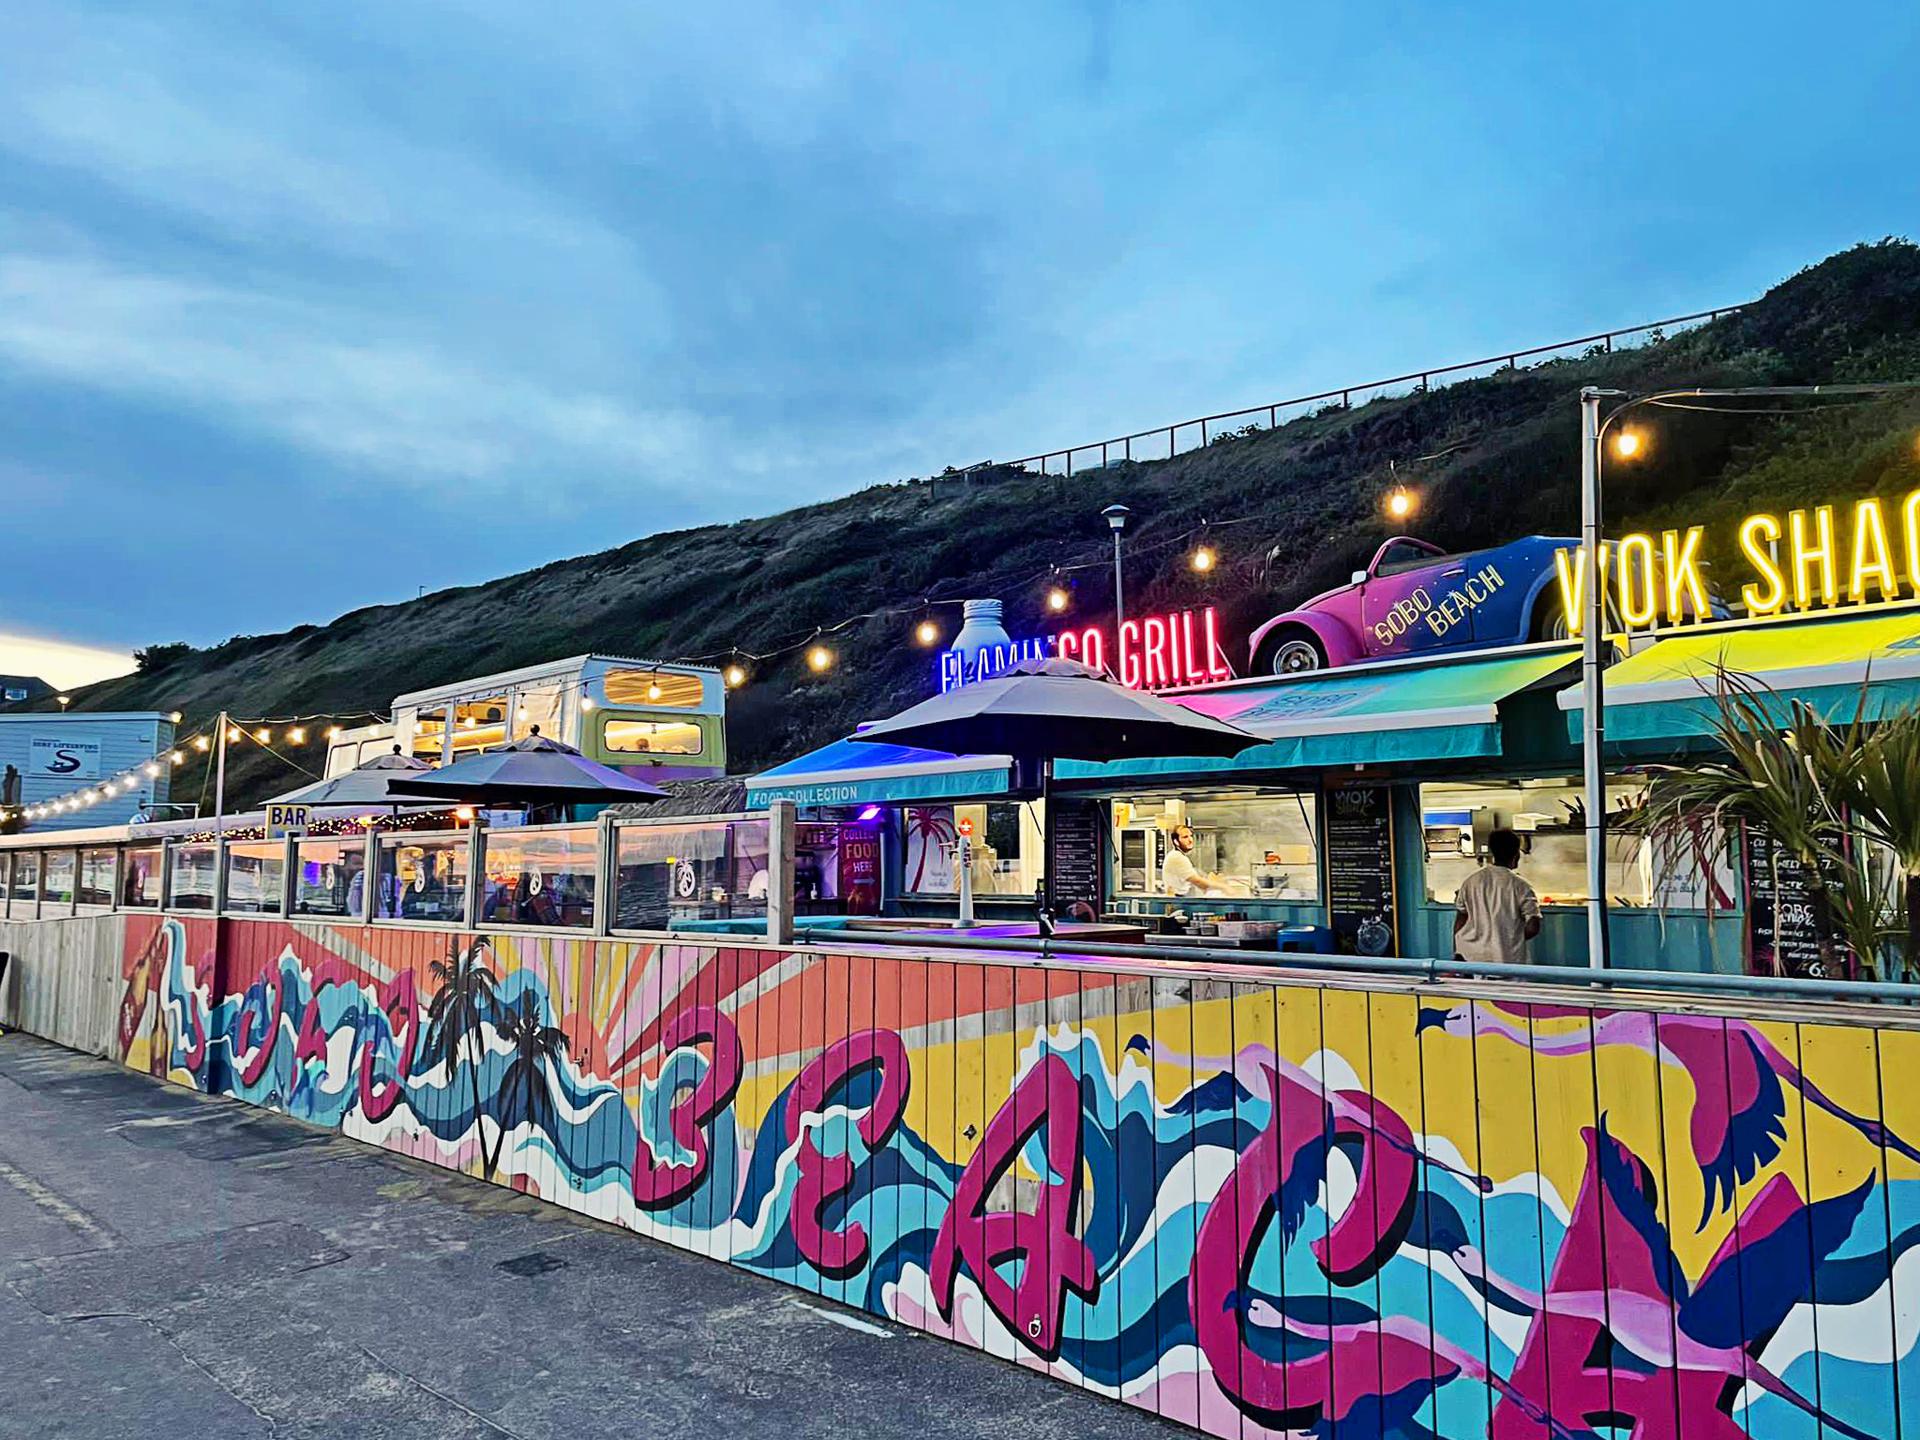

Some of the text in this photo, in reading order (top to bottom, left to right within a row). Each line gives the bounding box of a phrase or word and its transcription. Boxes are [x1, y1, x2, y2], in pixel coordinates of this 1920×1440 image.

[1555, 525, 1713, 635] WOK
[1425, 564, 1505, 637] BEACH
[1374, 588, 1433, 645] SOBO
[1119, 607, 1230, 690] GRILL
[787, 786, 858, 803] COLLECTION
[1335, 789, 1376, 805] WOK
[271, 807, 307, 826] BAR
[846, 843, 879, 859] FOOD
[852, 861, 874, 873] HERE
